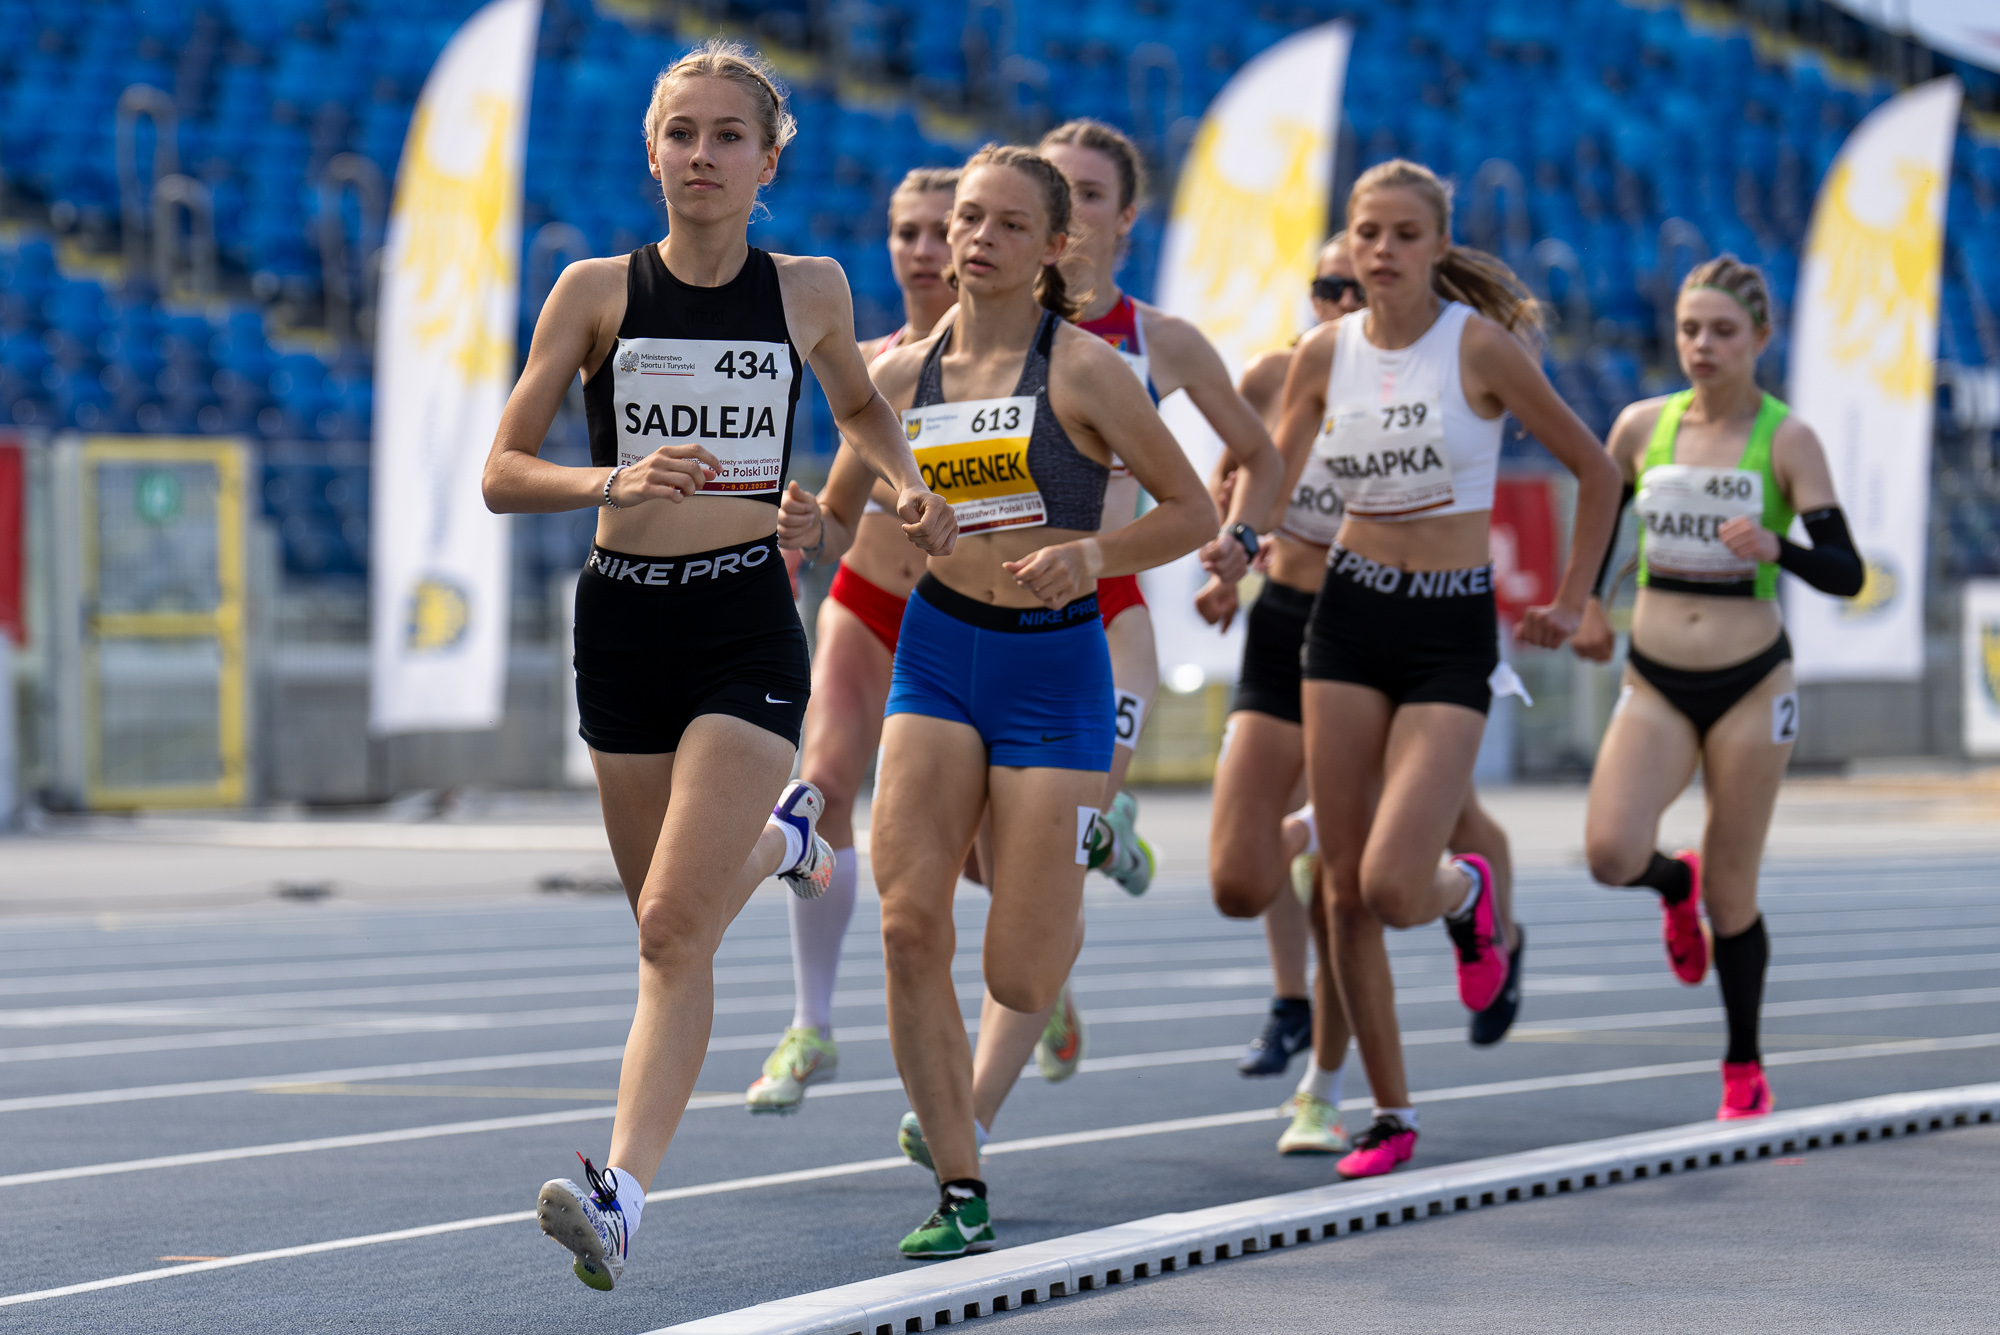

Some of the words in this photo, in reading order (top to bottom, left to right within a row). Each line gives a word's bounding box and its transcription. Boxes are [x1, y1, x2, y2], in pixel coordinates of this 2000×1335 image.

[641, 353, 682, 361] Ministerstwo
[641, 361, 661, 369] Sportu
[667, 362, 696, 371] Turystyki
[714, 350, 779, 380] 434
[625, 402, 776, 439] SADLEJA
[971, 406, 1021, 433] 613
[1381, 402, 1428, 430] 739
[733, 466, 761, 477] Polski
[763, 465, 780, 476] U18
[920, 451, 1027, 491] OCHENEK
[1290, 483, 1345, 515] RÓ
[1705, 475, 1753, 500] 450
[956, 508, 996, 521] strzostwa
[589, 550, 675, 586] NIKE
[680, 545, 770, 585] PRO
[1336, 549, 1401, 594] PRO
[1407, 565, 1488, 598] NIKE
[1018, 607, 1064, 626] NIKE
[1067, 598, 1097, 620] PRO
[1116, 695, 1137, 740] 5
[1780, 698, 1795, 737] 2
